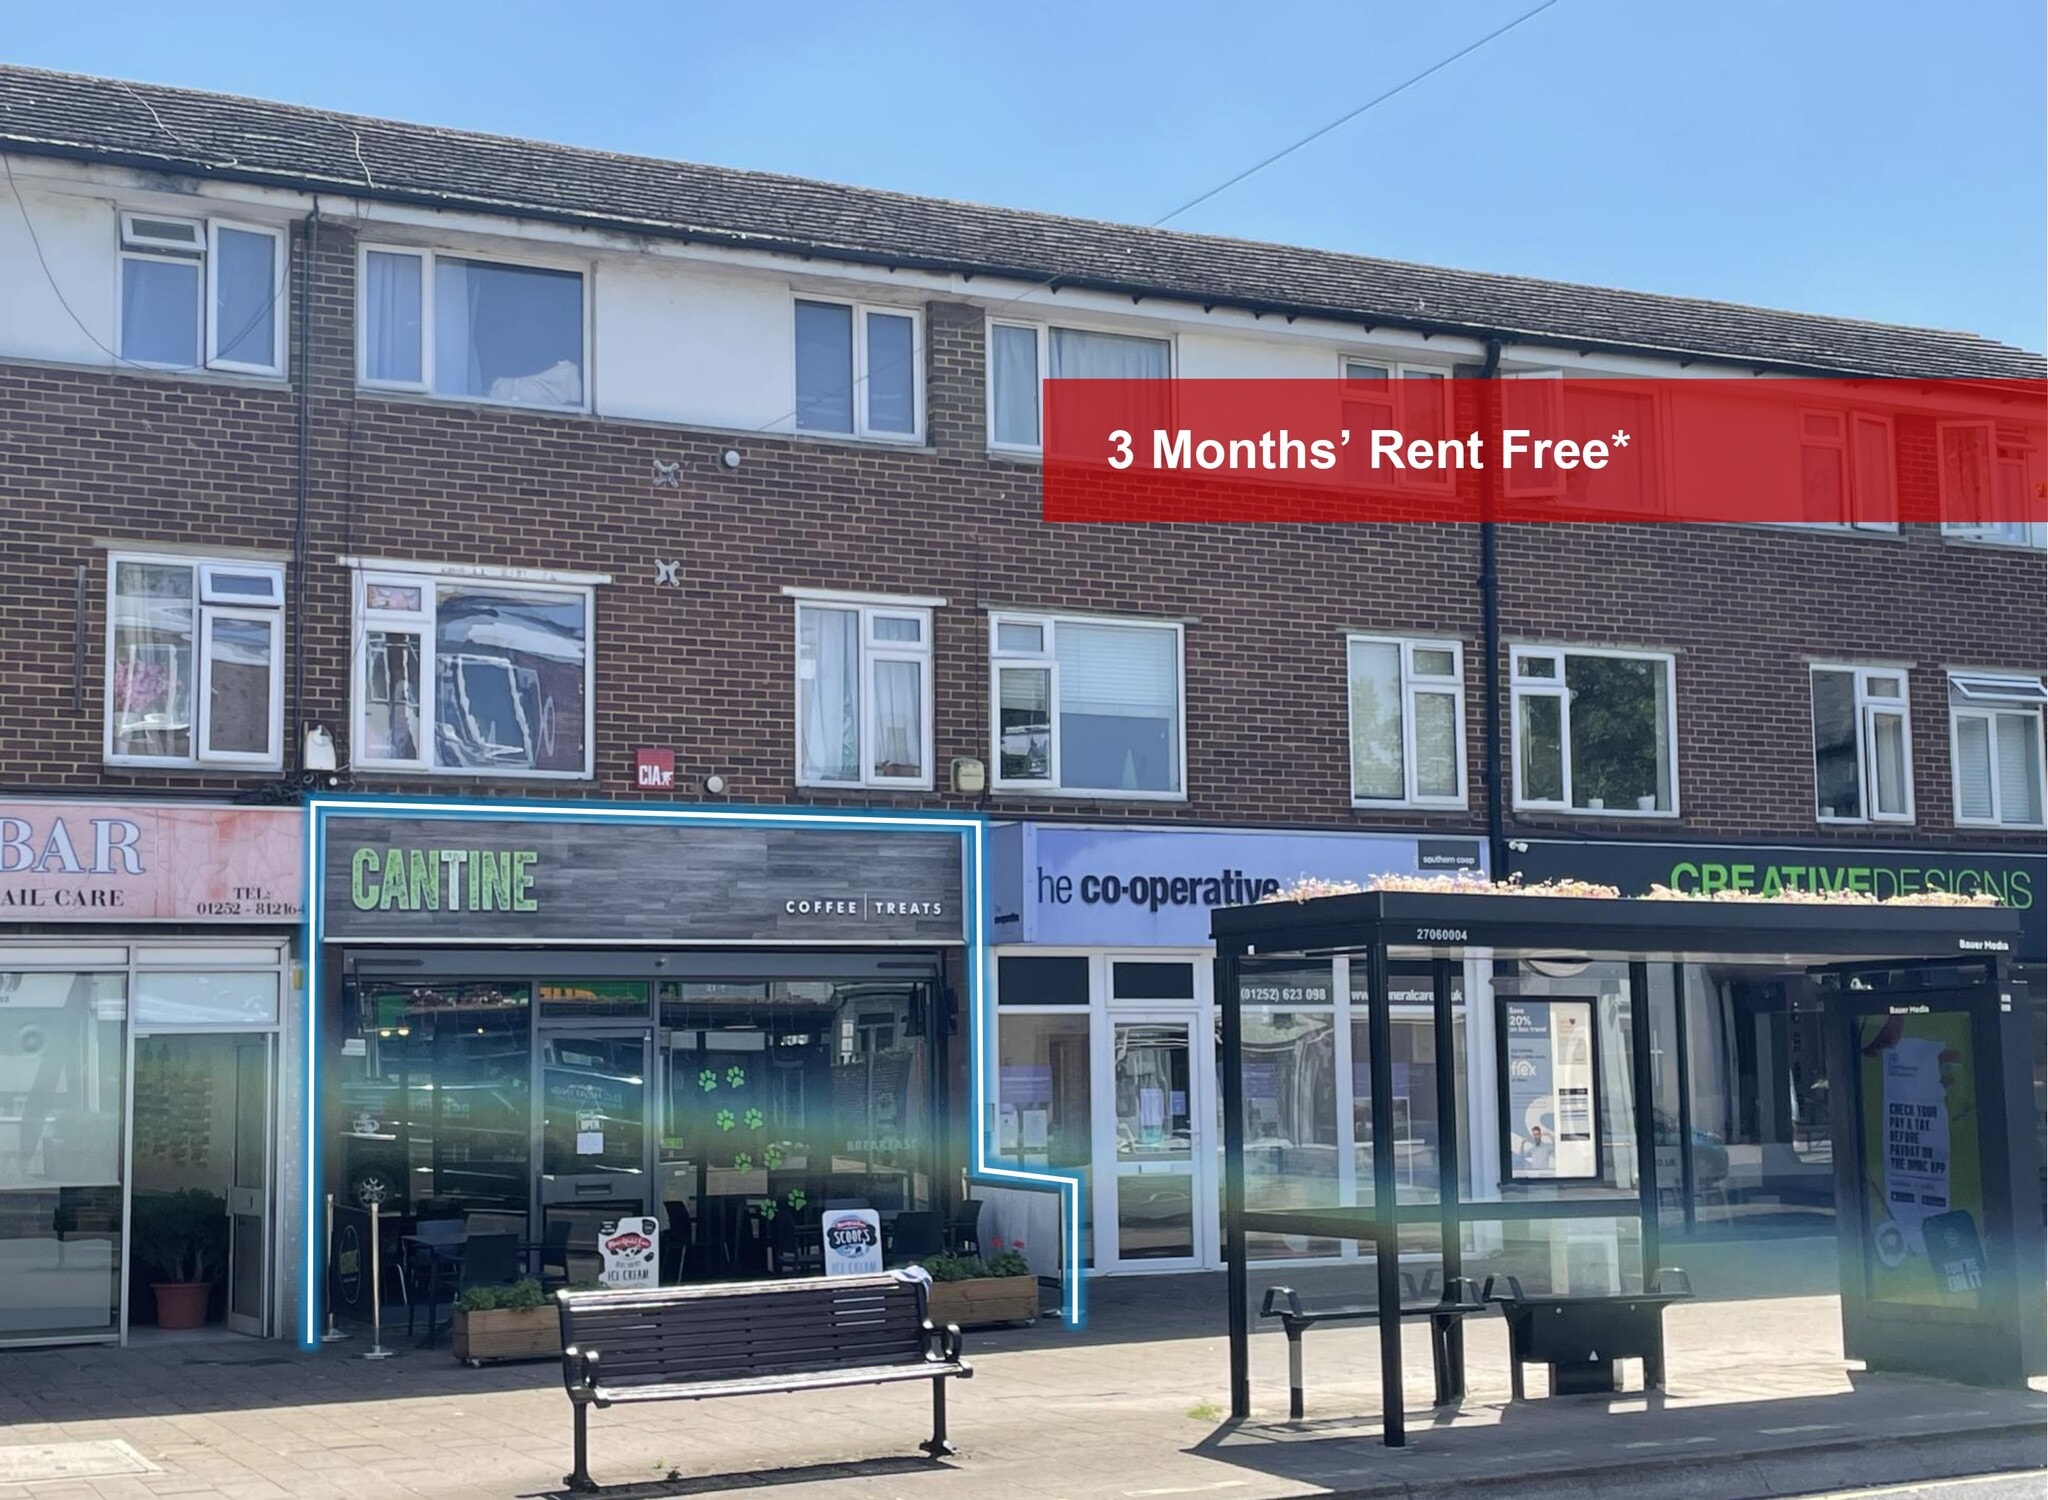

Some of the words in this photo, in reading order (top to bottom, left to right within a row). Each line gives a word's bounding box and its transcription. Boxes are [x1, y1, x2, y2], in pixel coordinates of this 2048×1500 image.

[638, 764, 661, 786] CIA
[0, 816, 147, 876] BAR
[1423, 855, 1455, 864] southern
[352, 847, 538, 912] CANTINE
[54, 888, 124, 907] CARE
[233, 887, 271, 901] TEL:
[1080, 869, 1281, 913] co-operative
[196, 902, 241, 916] 01252
[785, 900, 857, 914] COFFEE
[875, 902, 942, 915] TREATS
[1416, 928, 1468, 941] 27060004
[1959, 939, 1983, 950] Bauer
[1984, 940, 2009, 951] Media
[1240, 987, 1279, 1002] (01252)
[1282, 988, 1302, 1001] 623
[1305, 988, 1326, 1001] 098
[1889, 1006, 1909, 1015] Bauer
[1909, 1004, 1930, 1014] Media
[1509, 1015, 1532, 1026] 20%
[1889, 1102, 1914, 1117] CHECK
[1889, 1116, 1905, 1130] PAY
[1889, 1130, 1920, 1145] BEFORE
[1889, 1143, 1920, 1158] PAYDAY
[607, 1270, 620, 1282] ICE
[622, 1269, 649, 1281] CREAM
